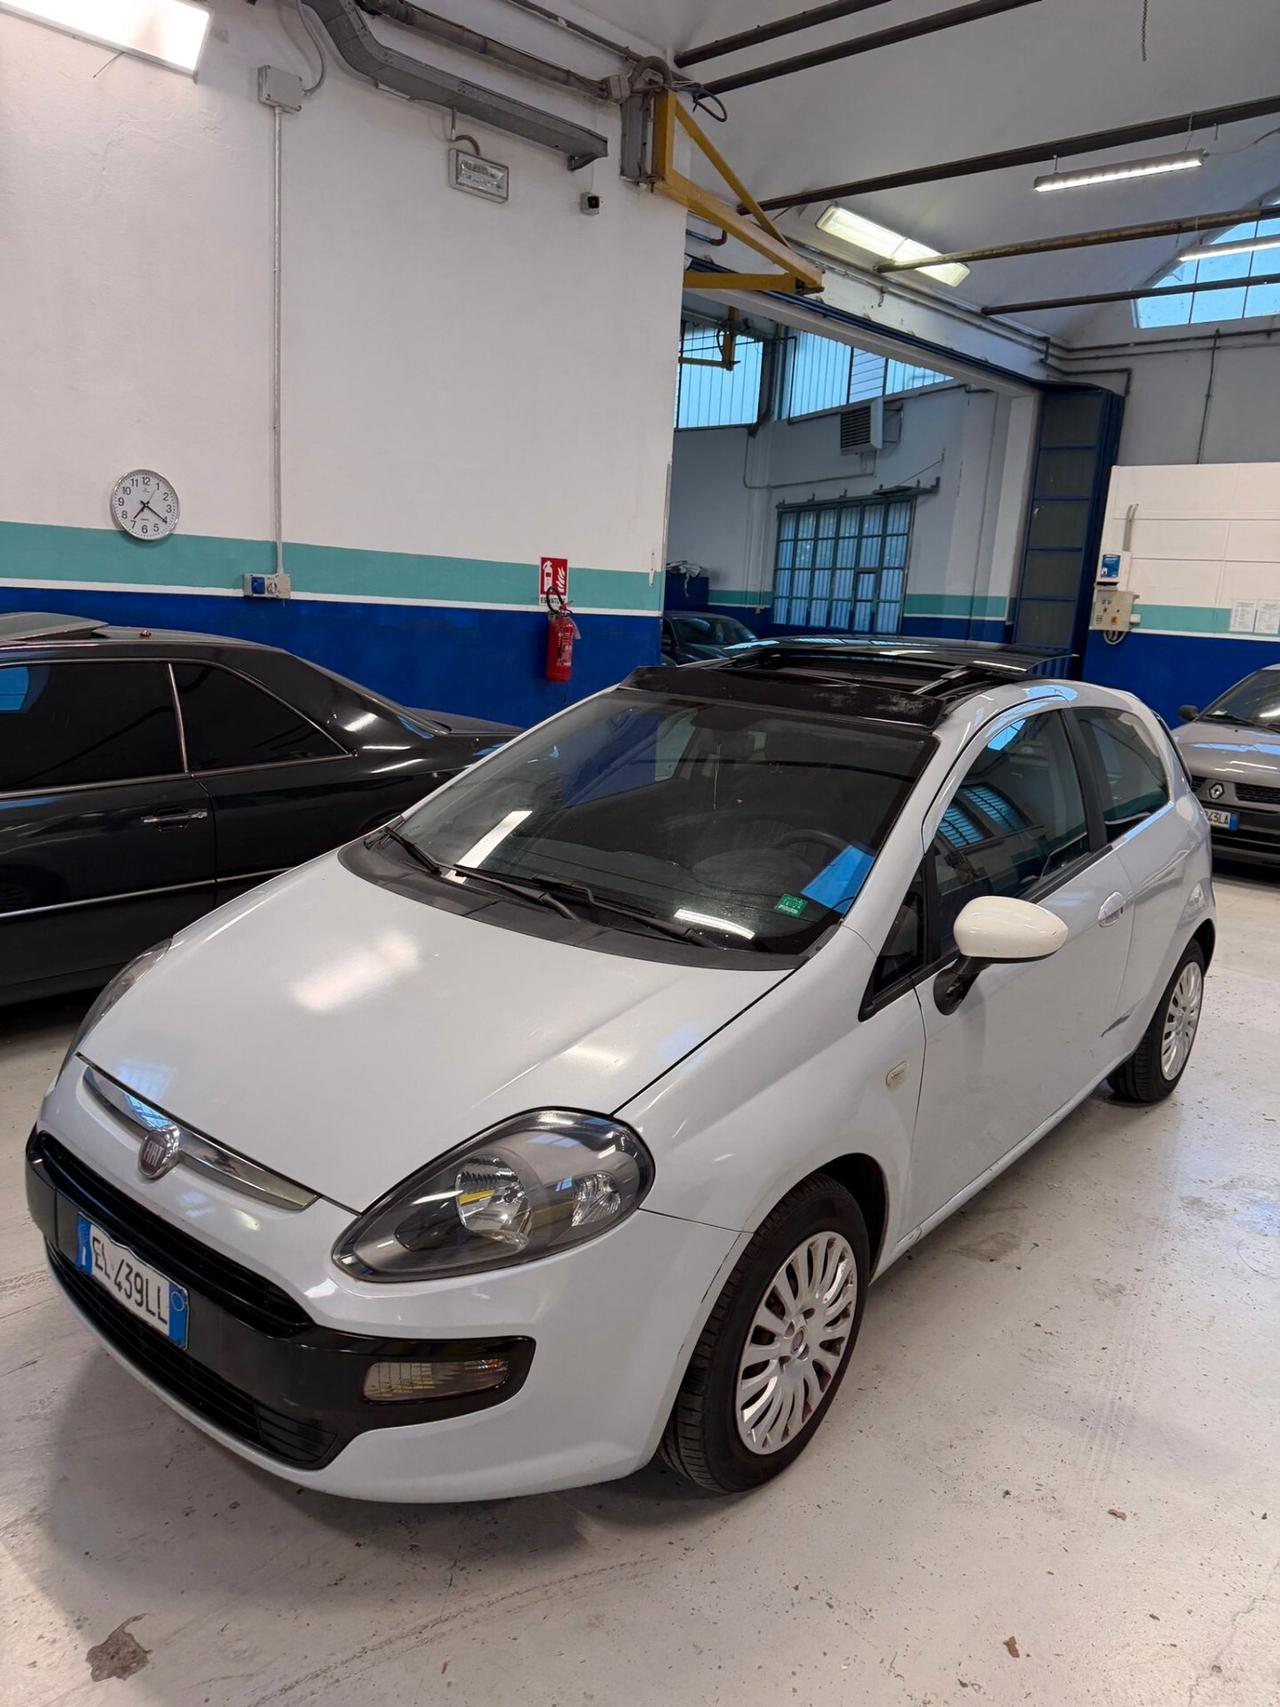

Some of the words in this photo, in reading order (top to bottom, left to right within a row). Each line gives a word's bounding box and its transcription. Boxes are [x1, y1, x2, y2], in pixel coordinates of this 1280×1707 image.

[131, 479, 138, 487] 11
[142, 476, 150, 486] 12
[122, 487, 131, 495] 10
[163, 492, 169, 501] 2
[118, 497, 124, 506] 9
[166, 504, 172, 513] 3
[122, 511, 128, 519] 8
[130, 520, 136, 528] 7
[153, 523, 159, 532] 5
[142, 525, 148, 534] 6
